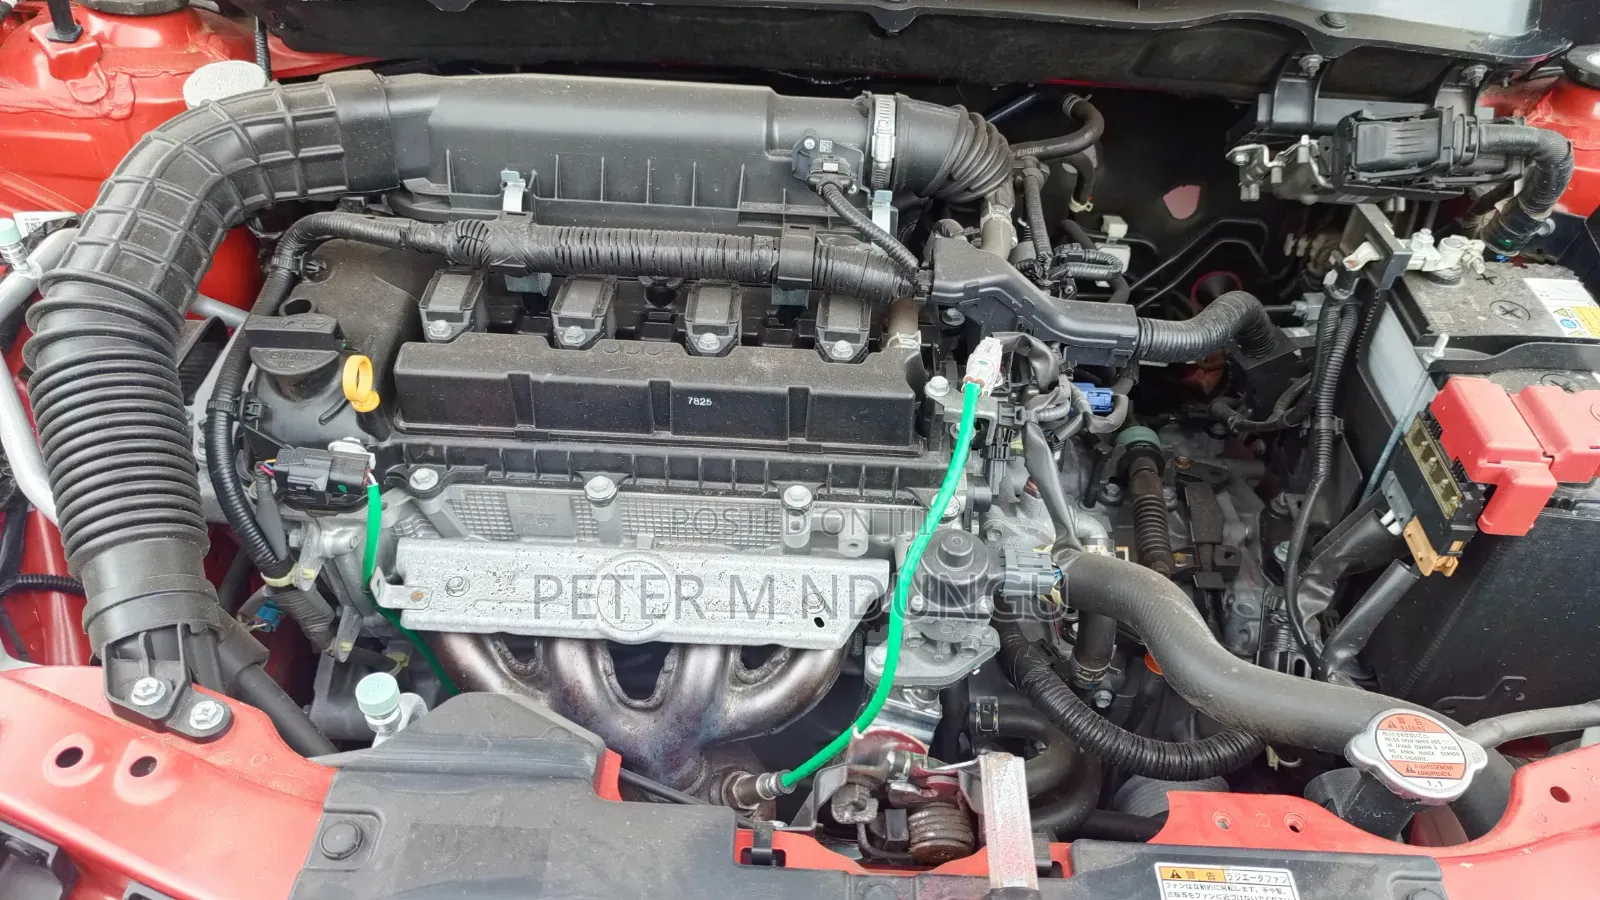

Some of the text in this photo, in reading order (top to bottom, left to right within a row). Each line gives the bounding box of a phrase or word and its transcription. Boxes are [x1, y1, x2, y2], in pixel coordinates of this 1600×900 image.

[1017, 146, 1045, 157] ENGINE
[687, 396, 713, 406] 7825
[1426, 780, 1443, 788] 1.1
